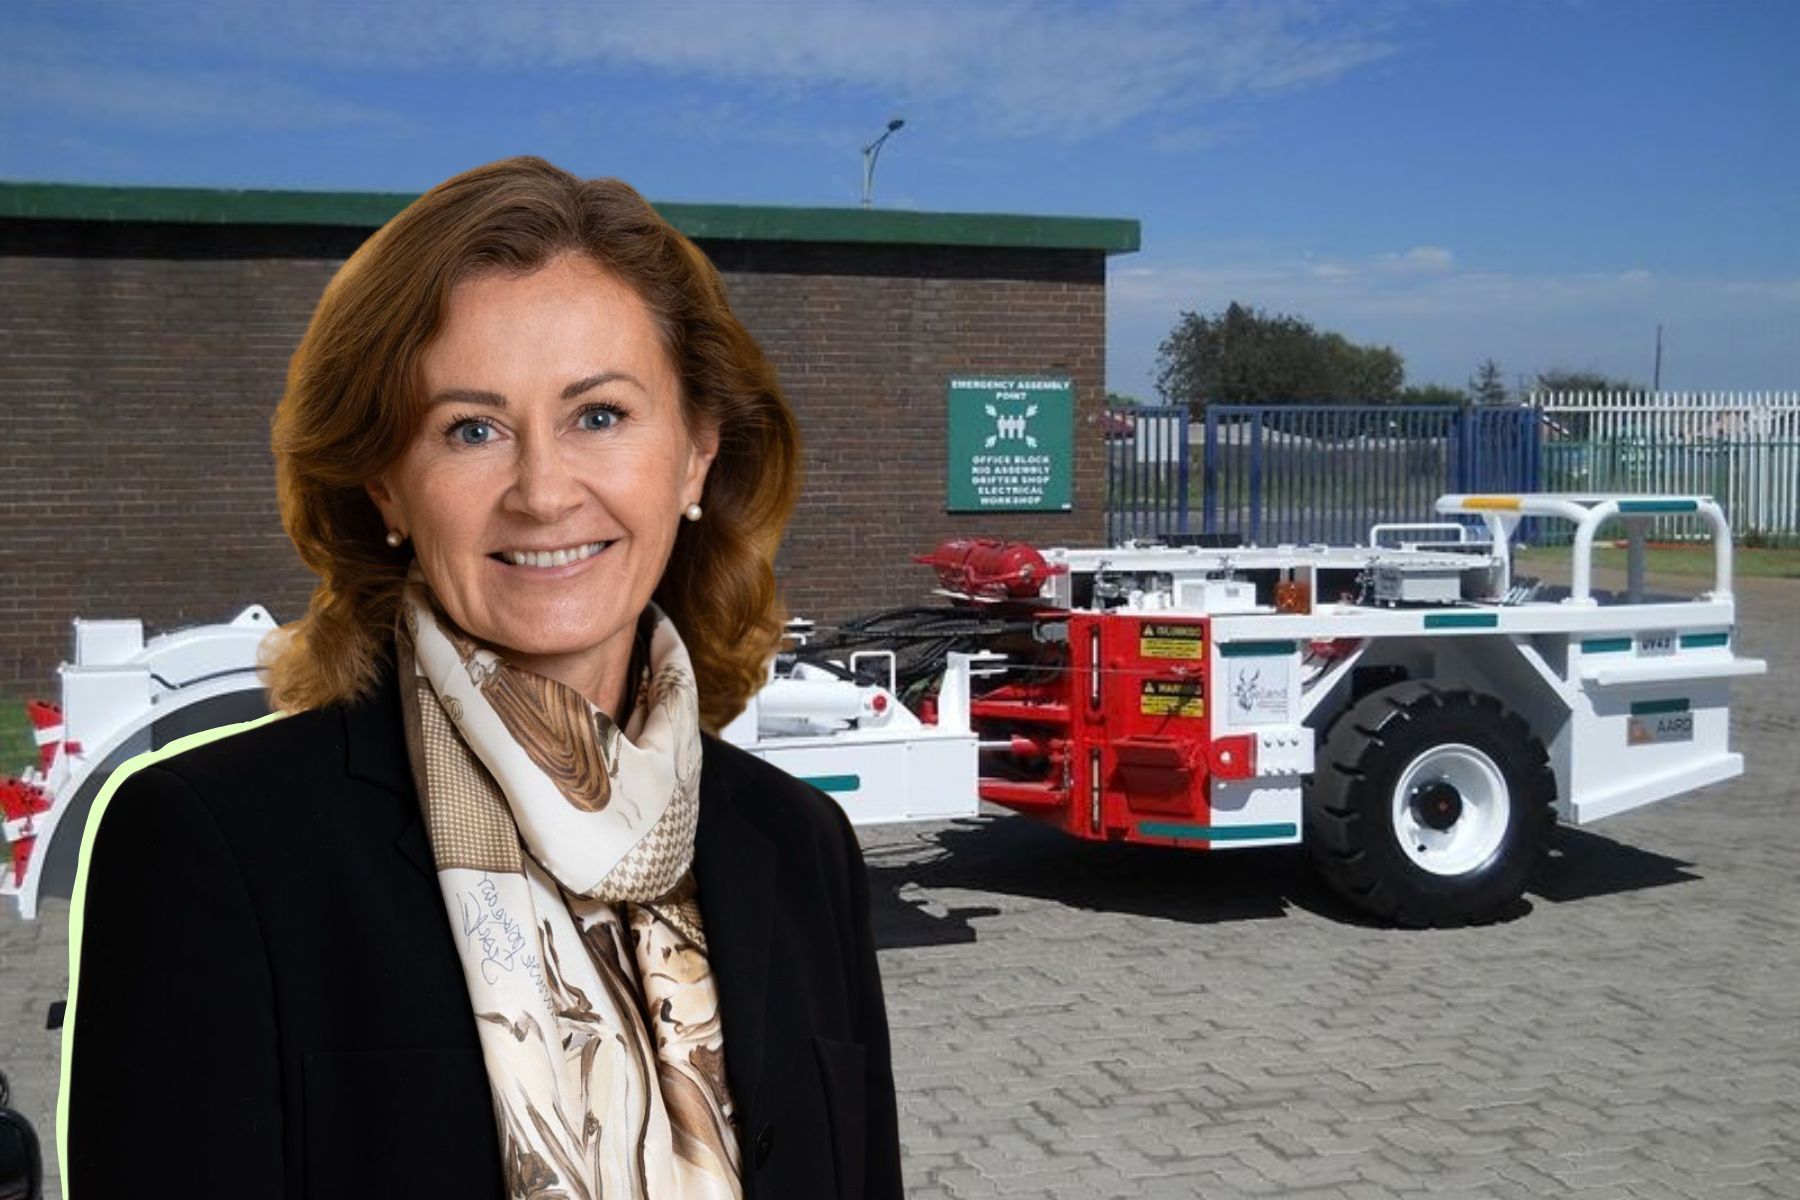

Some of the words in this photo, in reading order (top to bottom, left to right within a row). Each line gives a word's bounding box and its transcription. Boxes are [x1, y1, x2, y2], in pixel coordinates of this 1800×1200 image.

[951, 381, 1015, 389] EMERGENCY
[1017, 381, 1070, 390] ASSEMBLY
[996, 392, 1027, 400] POINT
[972, 455, 1011, 464] OFFICE
[1014, 455, 1049, 464] BLOCK
[994, 466, 1049, 474] ASSEMBLY
[1021, 475, 1050, 484] SHOP
[978, 486, 1044, 495] ELECTRICAL
[980, 496, 1042, 505] WORKSHOP
